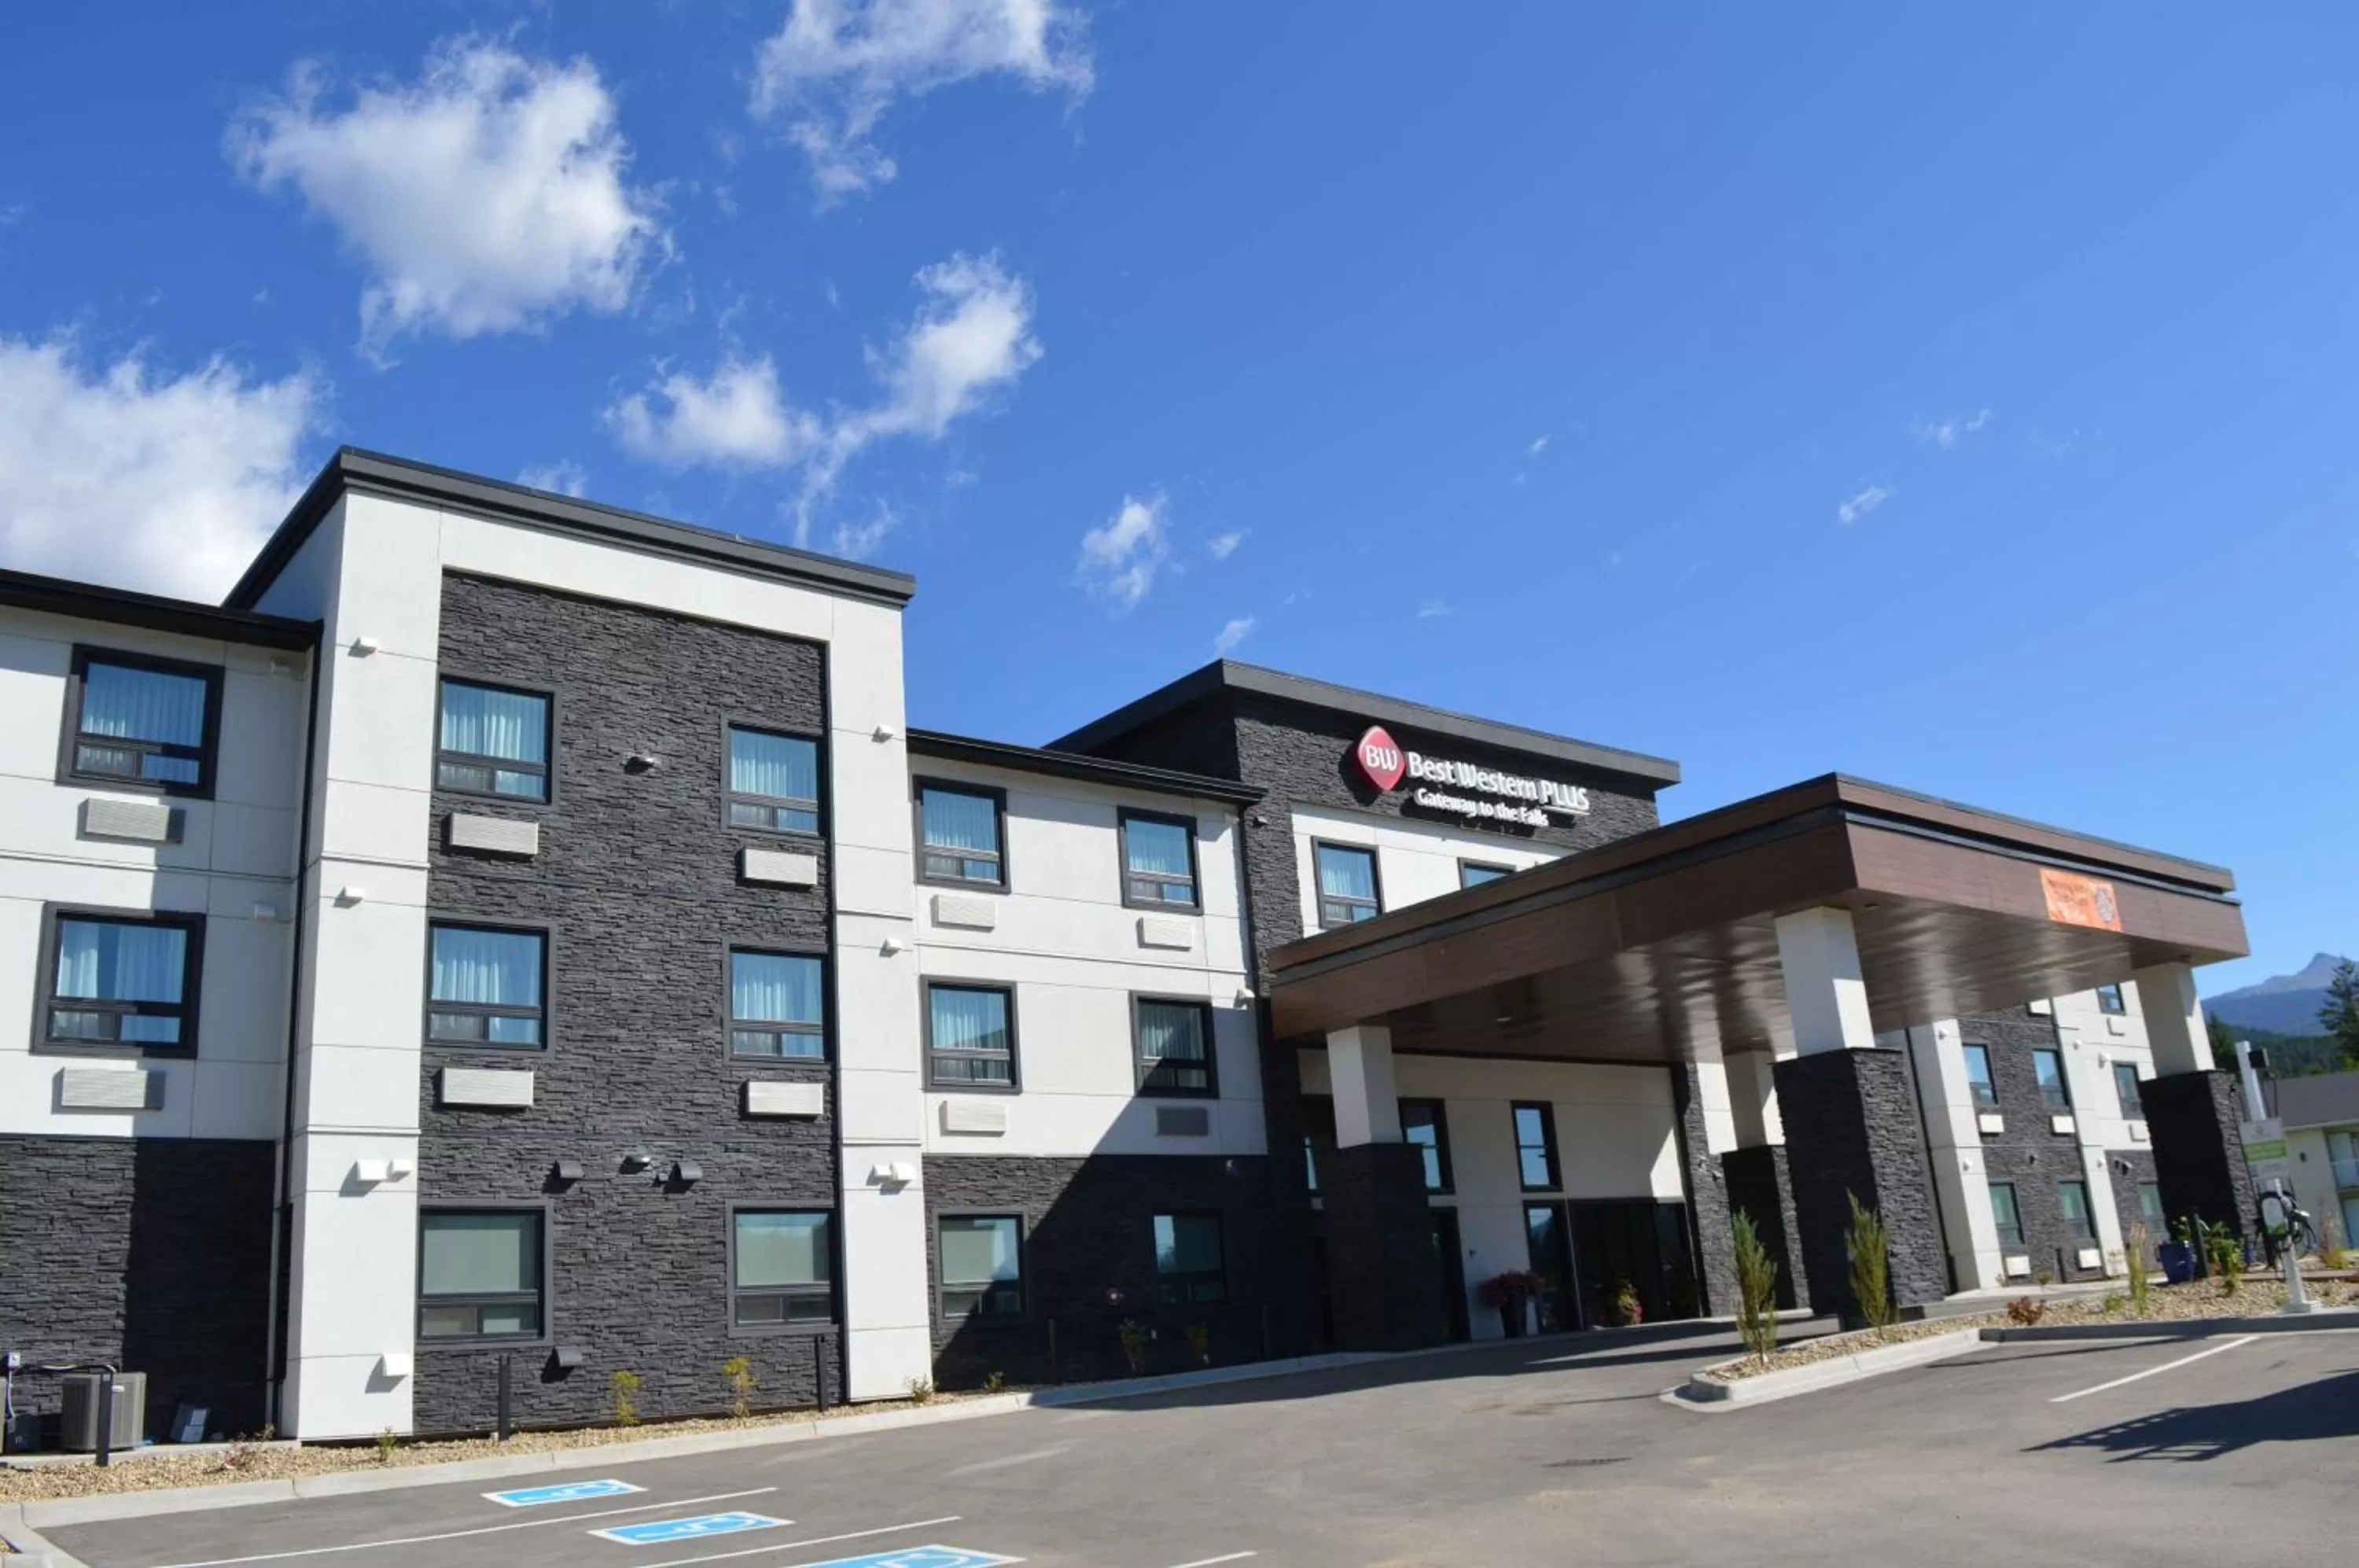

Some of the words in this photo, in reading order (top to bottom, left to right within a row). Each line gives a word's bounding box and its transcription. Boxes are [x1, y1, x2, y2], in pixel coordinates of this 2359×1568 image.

[1365, 745, 1397, 771] BW
[1408, 751, 1456, 784] Best
[1456, 761, 1539, 800] Western
[1539, 779, 1589, 811] PLUS
[1415, 788, 1477, 818] Gateway
[1478, 801, 1494, 817] to
[1496, 802, 1518, 821] the
[1518, 807, 1549, 827] Falls
